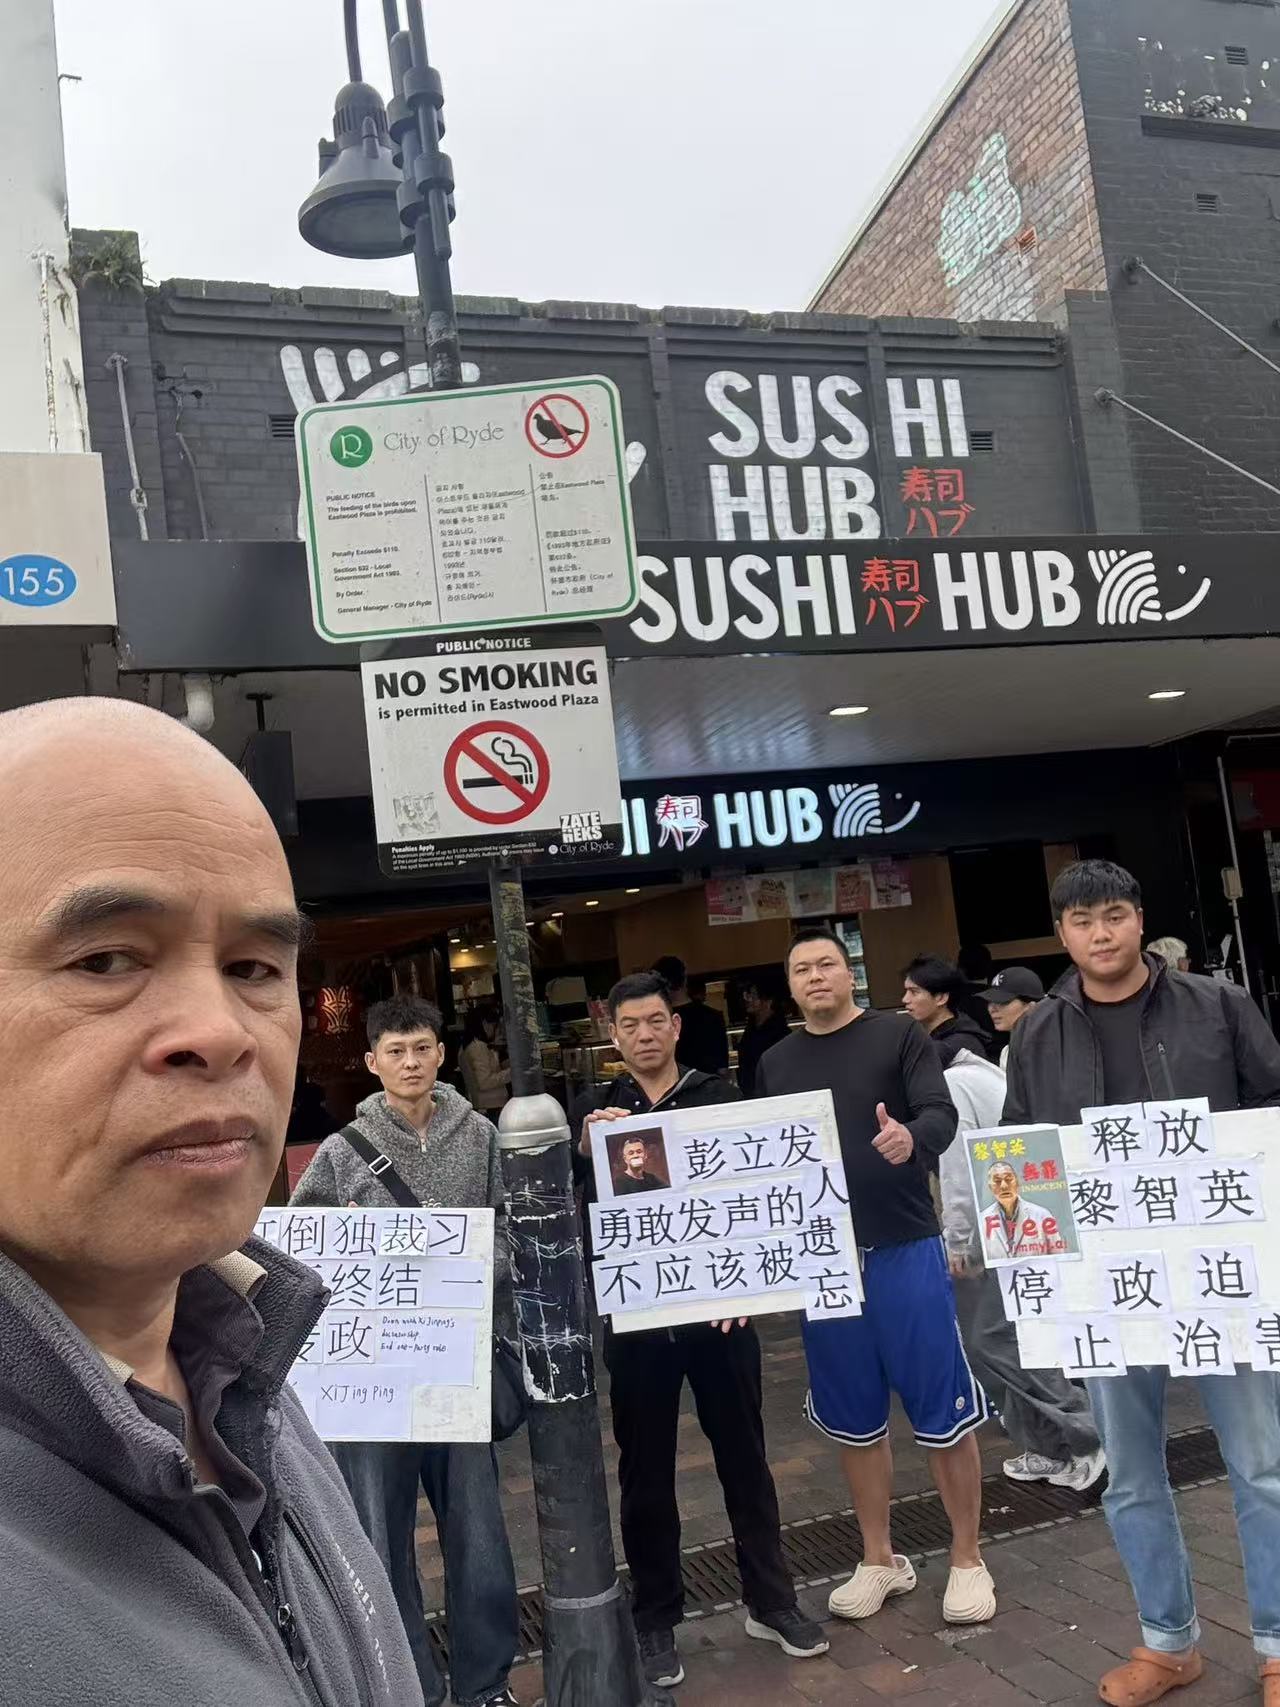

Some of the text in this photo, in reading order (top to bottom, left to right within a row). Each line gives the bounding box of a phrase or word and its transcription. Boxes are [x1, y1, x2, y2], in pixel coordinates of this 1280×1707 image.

[705, 370, 970, 460] SUSHI
[384, 422, 504, 455] City of Ryde
[326, 492, 375, 502] PUBLIC NOTICE
[900, 466, 967, 502] 寿司
[328, 512, 358, 520] Eastwood
[340, 504, 363, 512] feeding
[708, 464, 882, 541] HUB
[907, 502, 976, 538] ハブ
[4, 567, 65, 597] 155
[334, 573, 372, 582] Government
[860, 556, 920, 593] 寿司
[933, 549, 1081, 632] HUB
[629, 553, 857, 643] SUSHI
[866, 596, 931, 632] ハブ
[436, 637, 532, 653] PUBLIC NOTICE
[374, 659, 598, 699] NO SMOKING
[378, 692, 600, 721] is permitted in Eastwood Plaza
[713, 787, 823, 849] HUB
[392, 844, 434, 854] Penalties Apply
[560, 840, 615, 856] City of Ryde
[684, 1124, 822, 1181] 彭立发
[1091, 1108, 1209, 1163] 释放
[1070, 1168, 1255, 1226] 黎智英
[985, 1215, 1057, 1240] Free
[311, 1262, 484, 1308] 终结一
